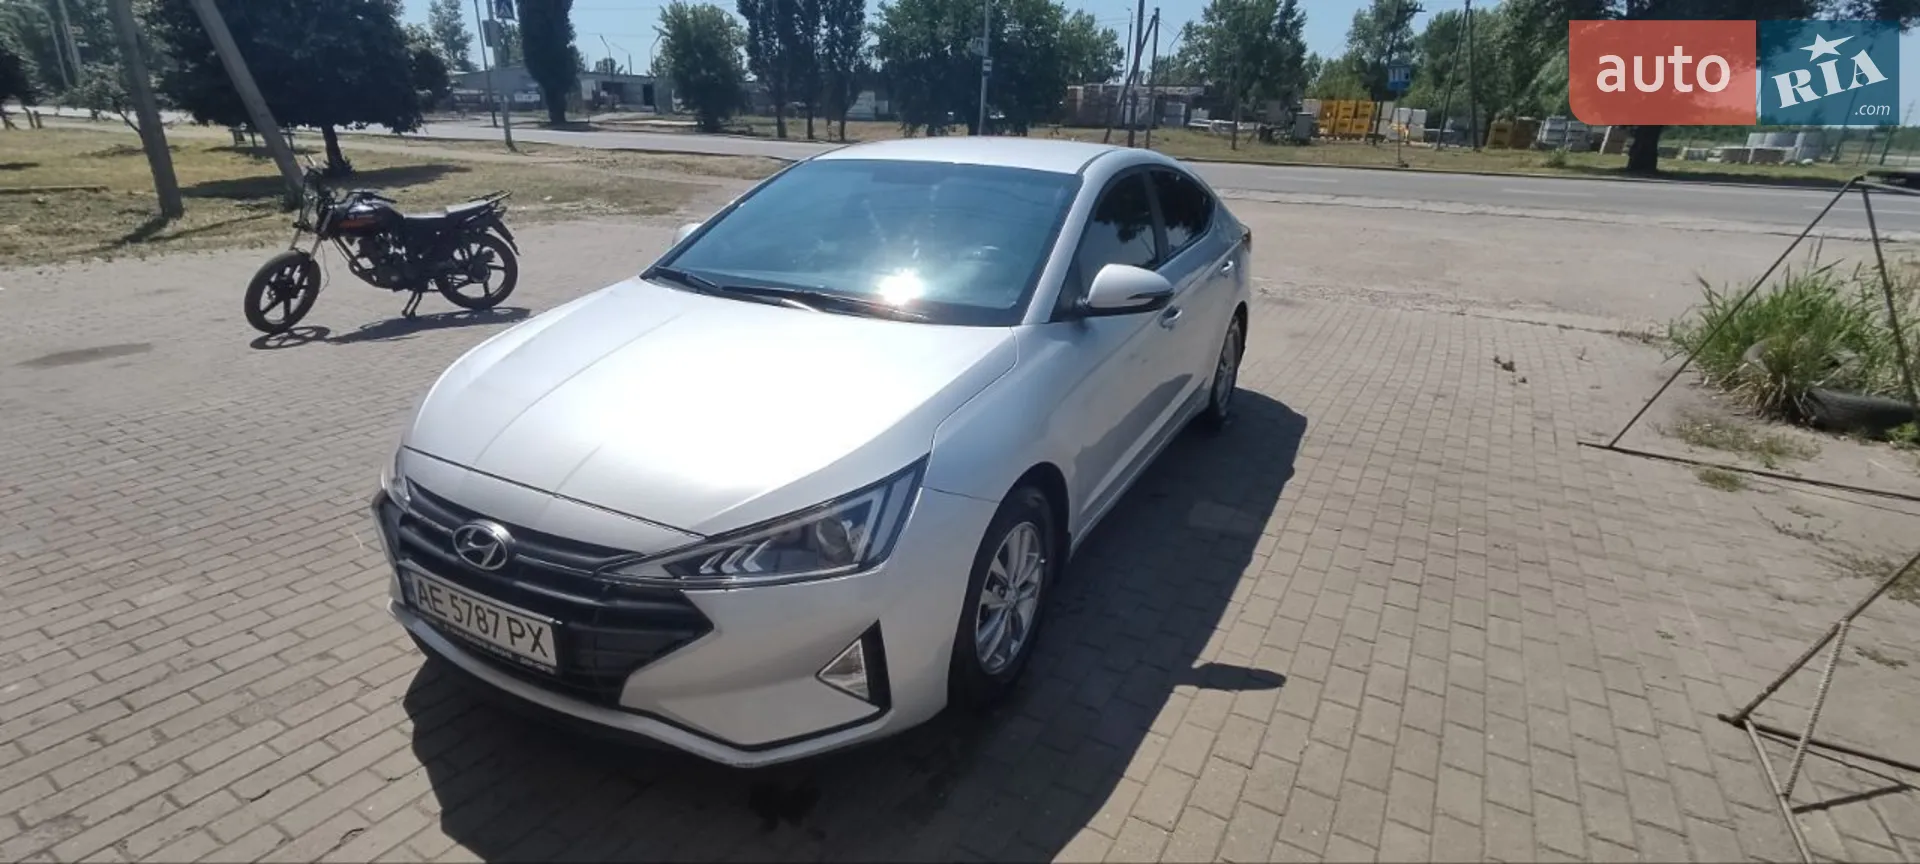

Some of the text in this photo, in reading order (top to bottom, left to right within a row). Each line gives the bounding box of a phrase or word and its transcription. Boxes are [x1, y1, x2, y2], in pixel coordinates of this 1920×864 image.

[417, 579, 447, 616] AE
[448, 594, 500, 639] 5787
[506, 616, 547, 657] PX
